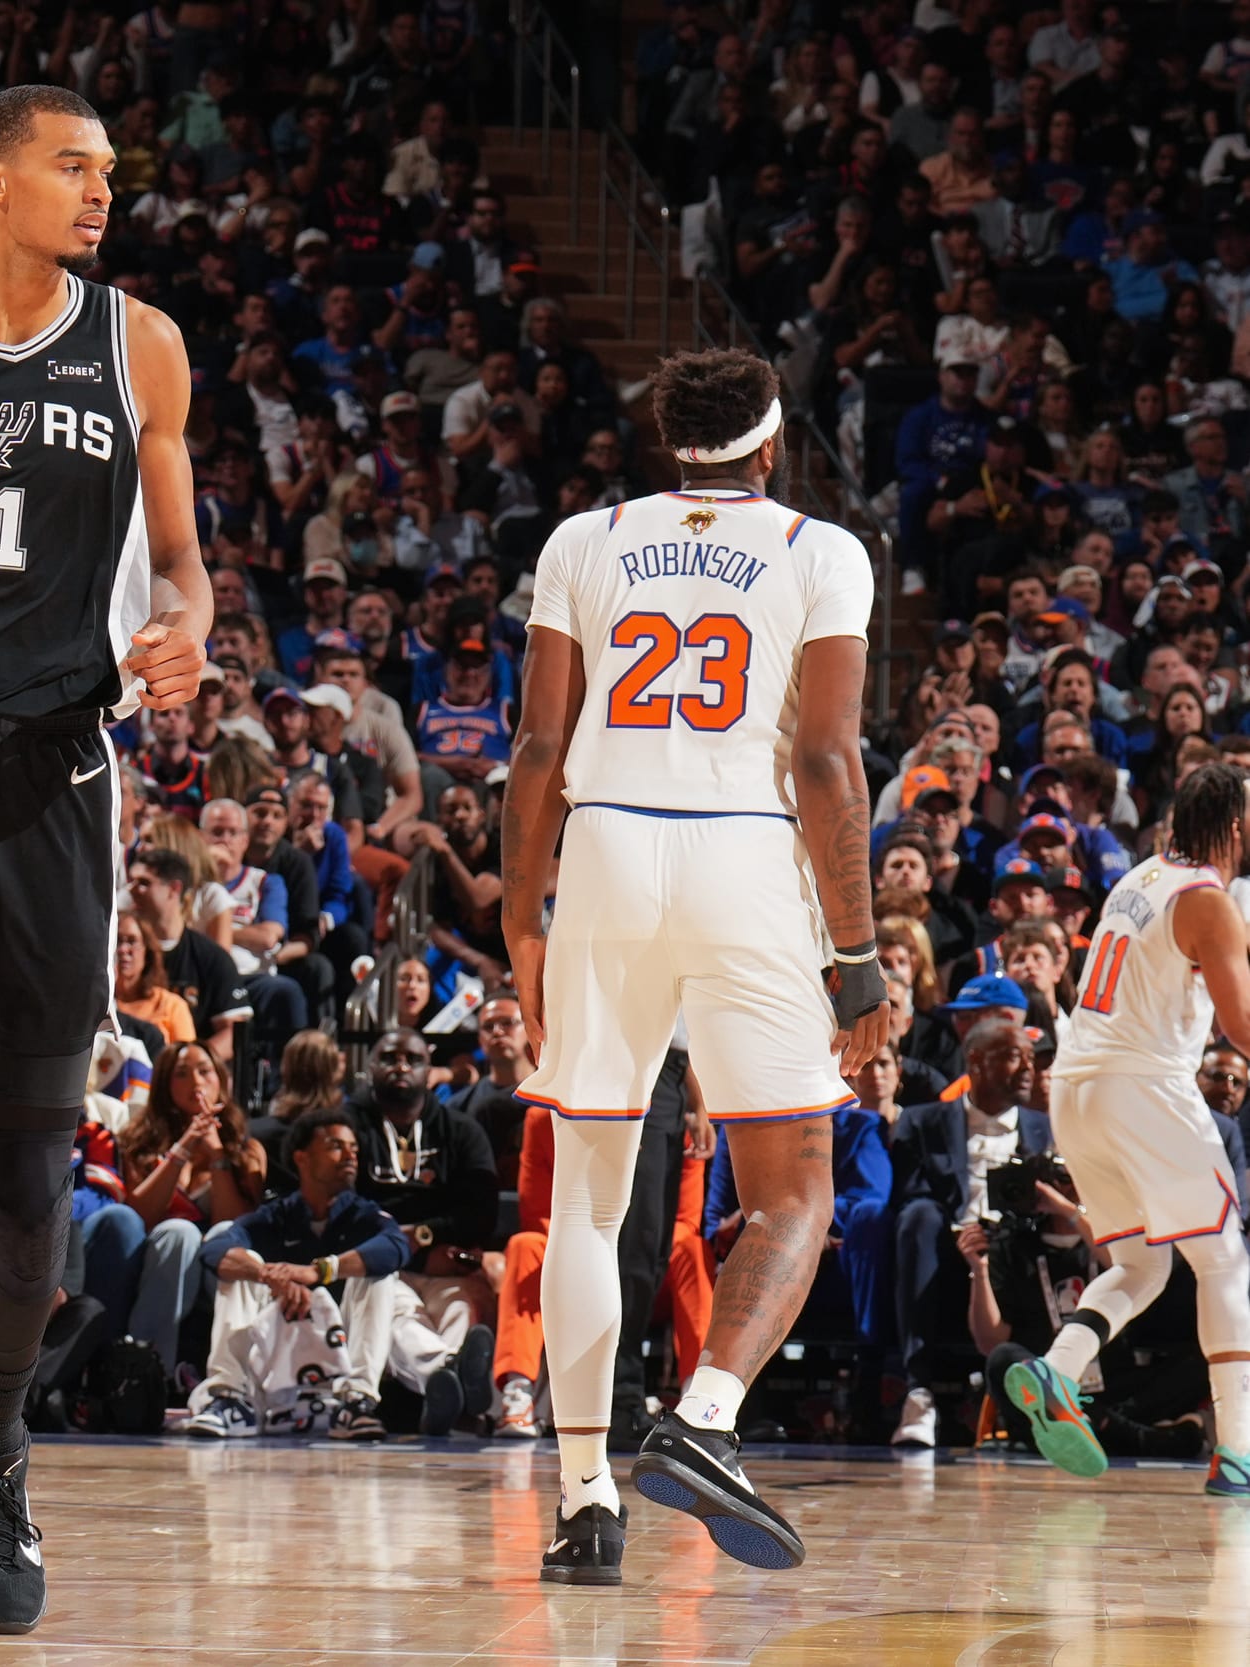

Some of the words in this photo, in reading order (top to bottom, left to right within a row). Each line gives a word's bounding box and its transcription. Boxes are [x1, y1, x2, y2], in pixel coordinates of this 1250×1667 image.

[54, 365, 95, 376] LEDGER
[620, 541, 768, 593] ROBINSON
[606, 610, 753, 732] 23
[1081, 930, 1130, 1015] 11
